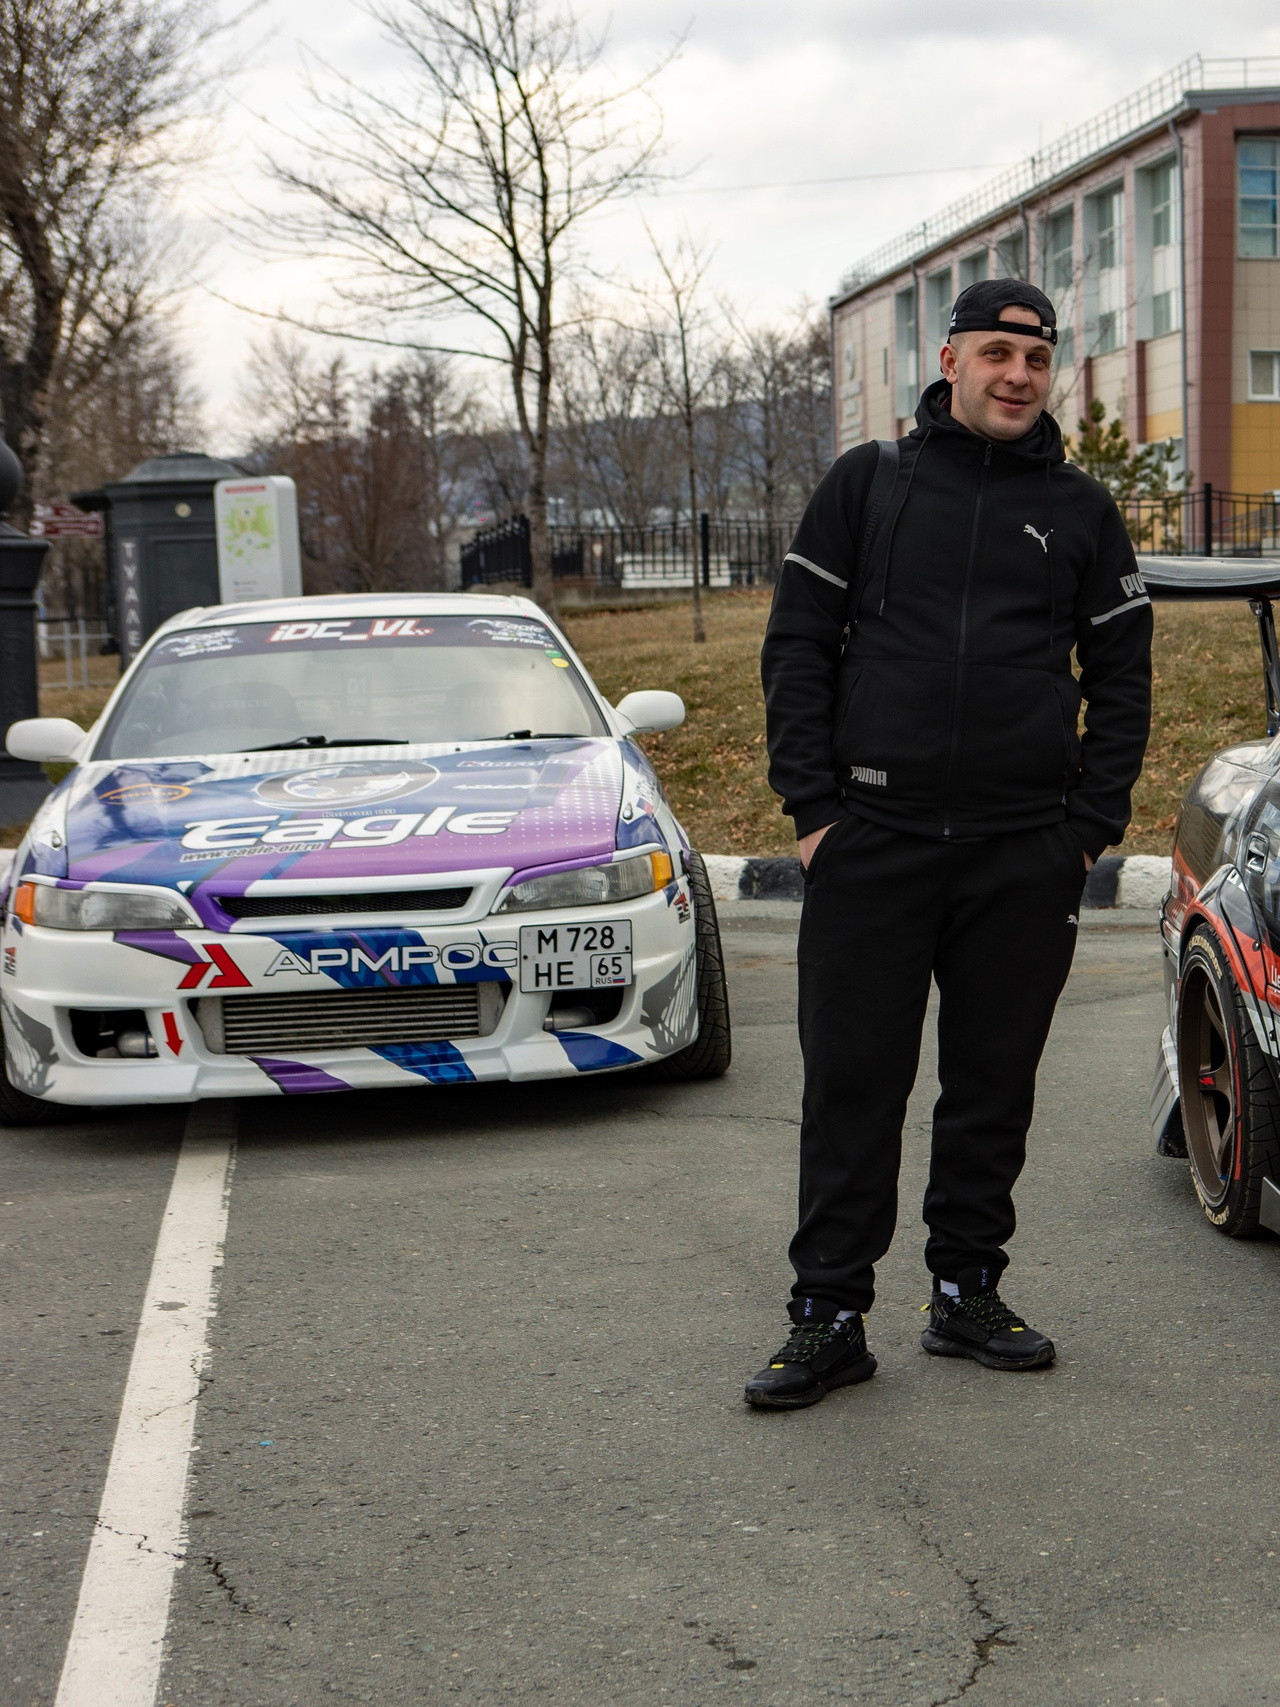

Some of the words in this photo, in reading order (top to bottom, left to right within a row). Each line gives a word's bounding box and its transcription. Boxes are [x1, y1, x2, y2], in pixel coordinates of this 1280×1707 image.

[850, 765, 887, 787] PUMA
[180, 806, 521, 850] Eagle
[180, 842, 326, 863] www.eagle-oil.ru
[264, 940, 518, 977] АРМРОС
[597, 956, 623, 976] 65
[595, 976, 613, 984] RUS
